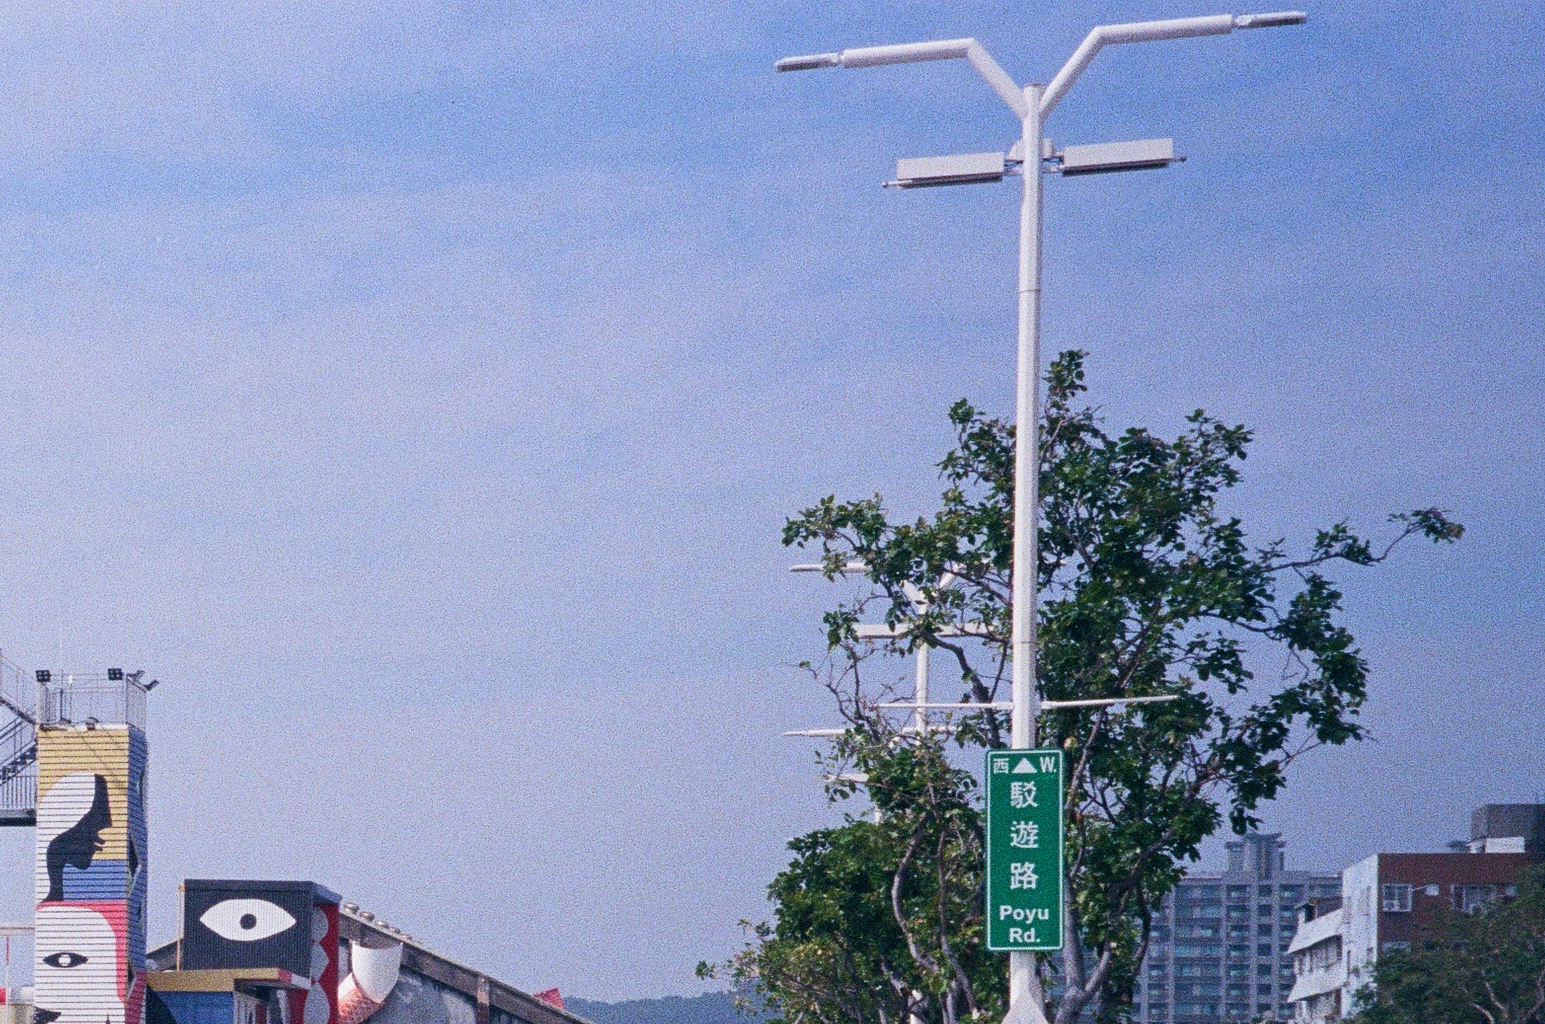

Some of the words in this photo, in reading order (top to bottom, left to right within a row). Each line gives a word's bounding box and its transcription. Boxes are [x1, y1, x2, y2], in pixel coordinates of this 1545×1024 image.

[993, 758, 1009, 774] 西
[1039, 756, 1057, 773] W.
[999, 905, 1049, 924] Poyu
[1009, 927, 1041, 943] Rd.
